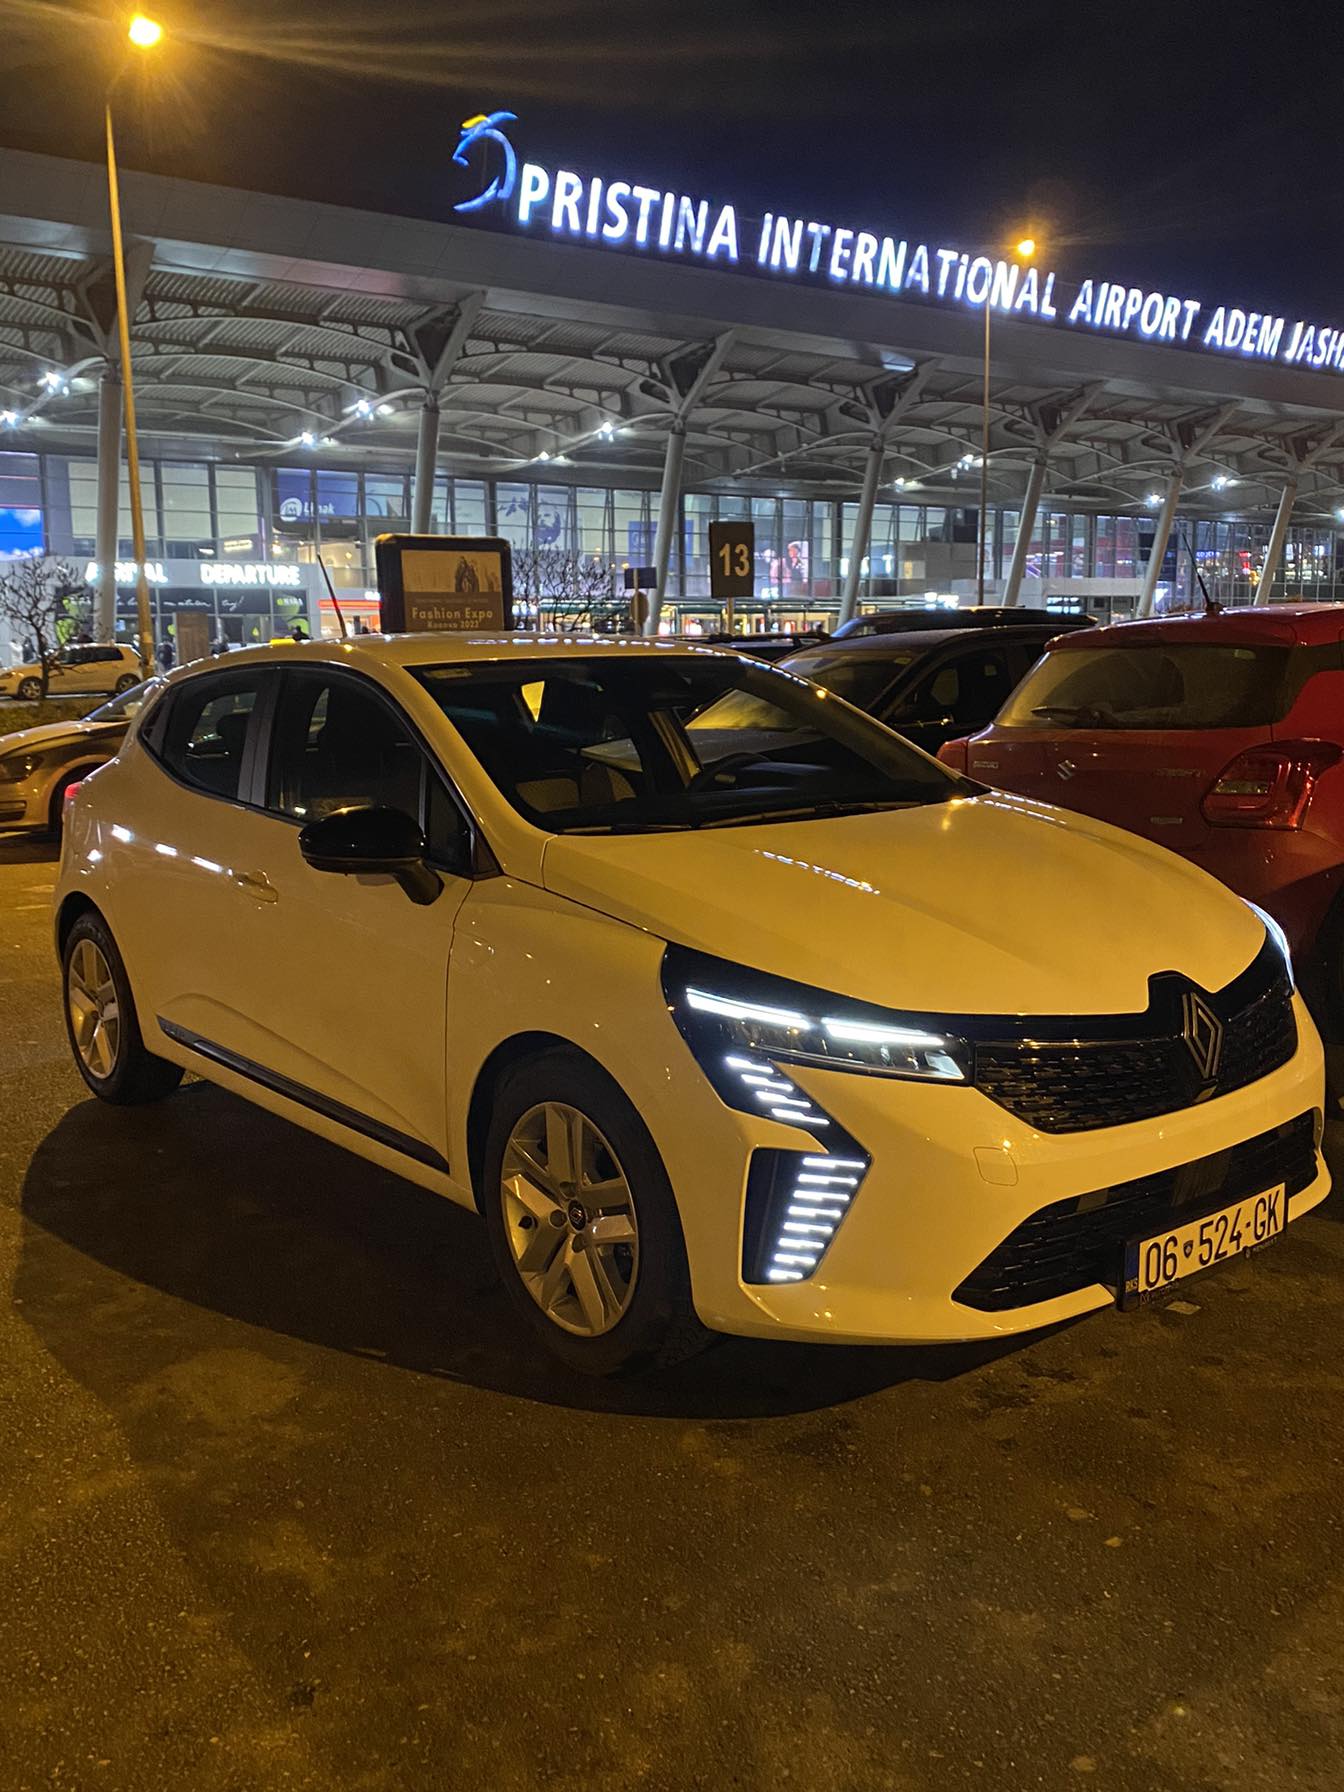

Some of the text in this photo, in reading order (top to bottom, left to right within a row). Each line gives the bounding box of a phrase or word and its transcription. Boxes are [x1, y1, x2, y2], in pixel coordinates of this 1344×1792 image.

[517, 163, 740, 260] PRISTINA
[757, 212, 1057, 318] INTERNATIONAL
[1068, 279, 1201, 342] AIRPORT
[1203, 306, 1285, 357] ADEM
[303, 501, 335, 514] Liak
[719, 543, 750, 577] 13
[199, 563, 301, 586] DEPARTURE
[411, 607, 493, 622] Fashion Expo
[1145, 1234, 1178, 1289] 06
